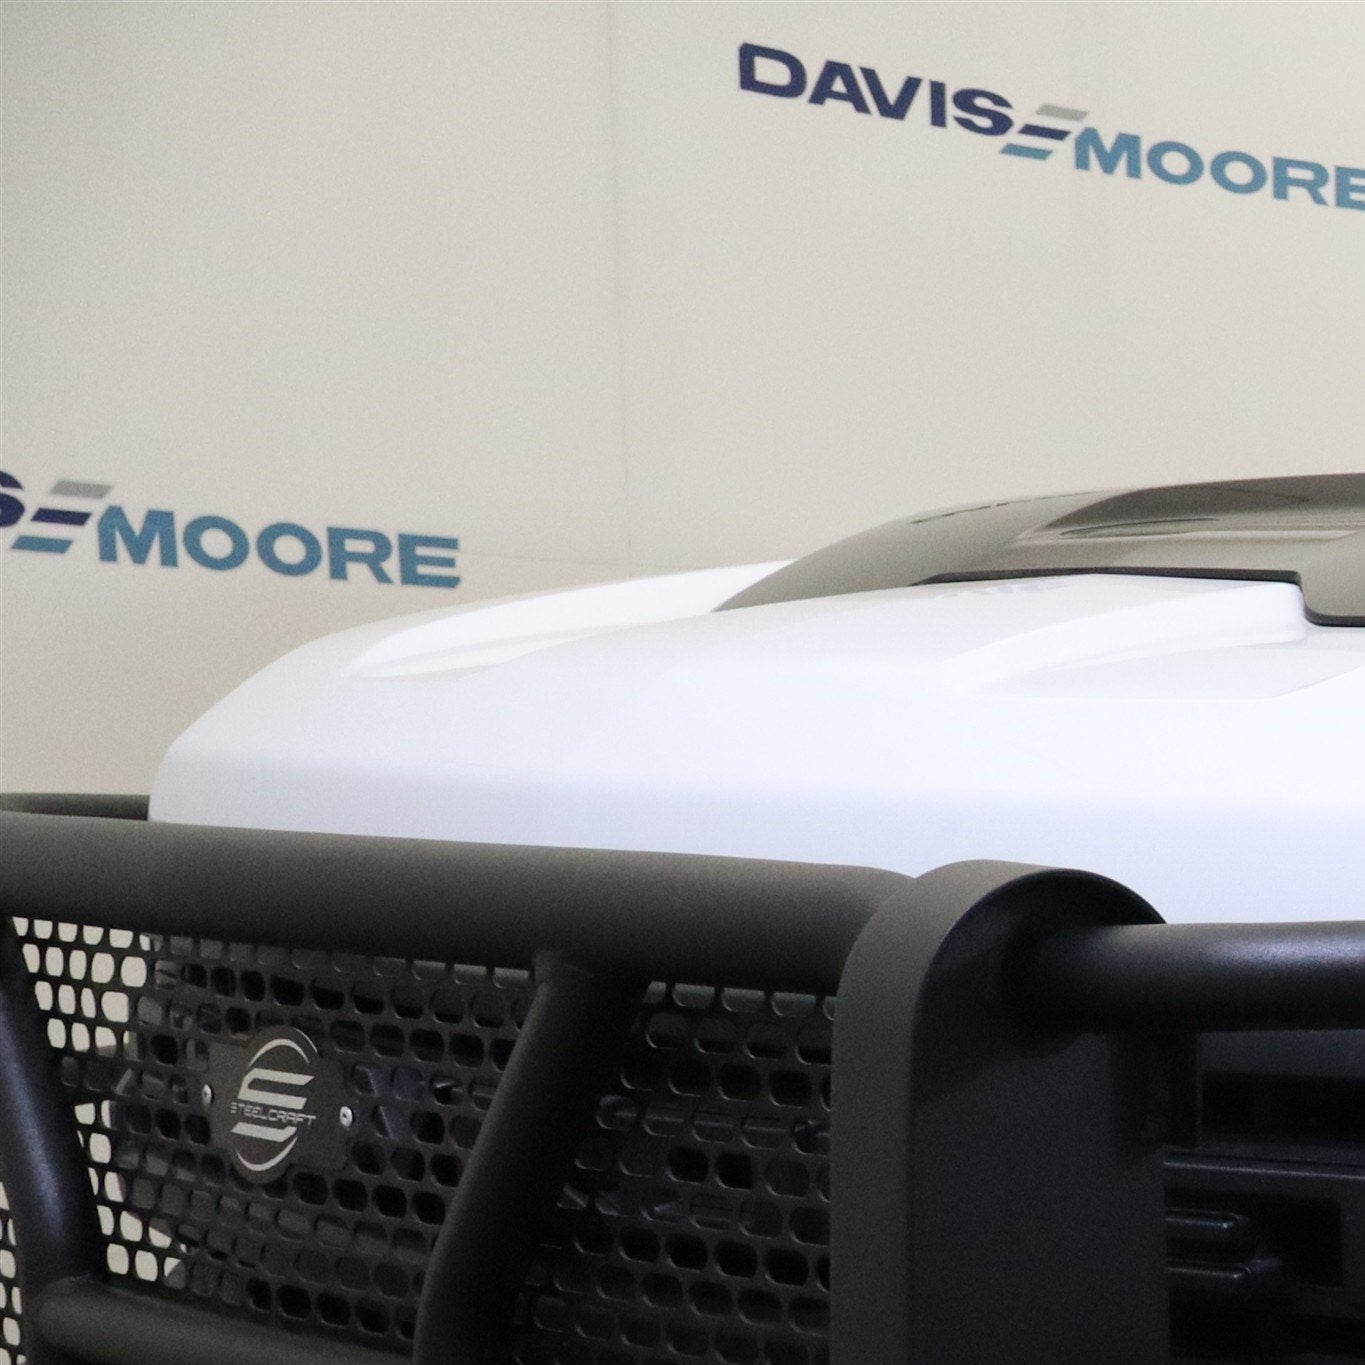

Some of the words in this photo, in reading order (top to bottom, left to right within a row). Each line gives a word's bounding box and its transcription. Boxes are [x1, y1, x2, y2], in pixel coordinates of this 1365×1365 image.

[738, 42, 1015, 137] DAVIS
[97, 505, 461, 589] MOORE
[230, 1101, 317, 1127] STEELCRAFT
